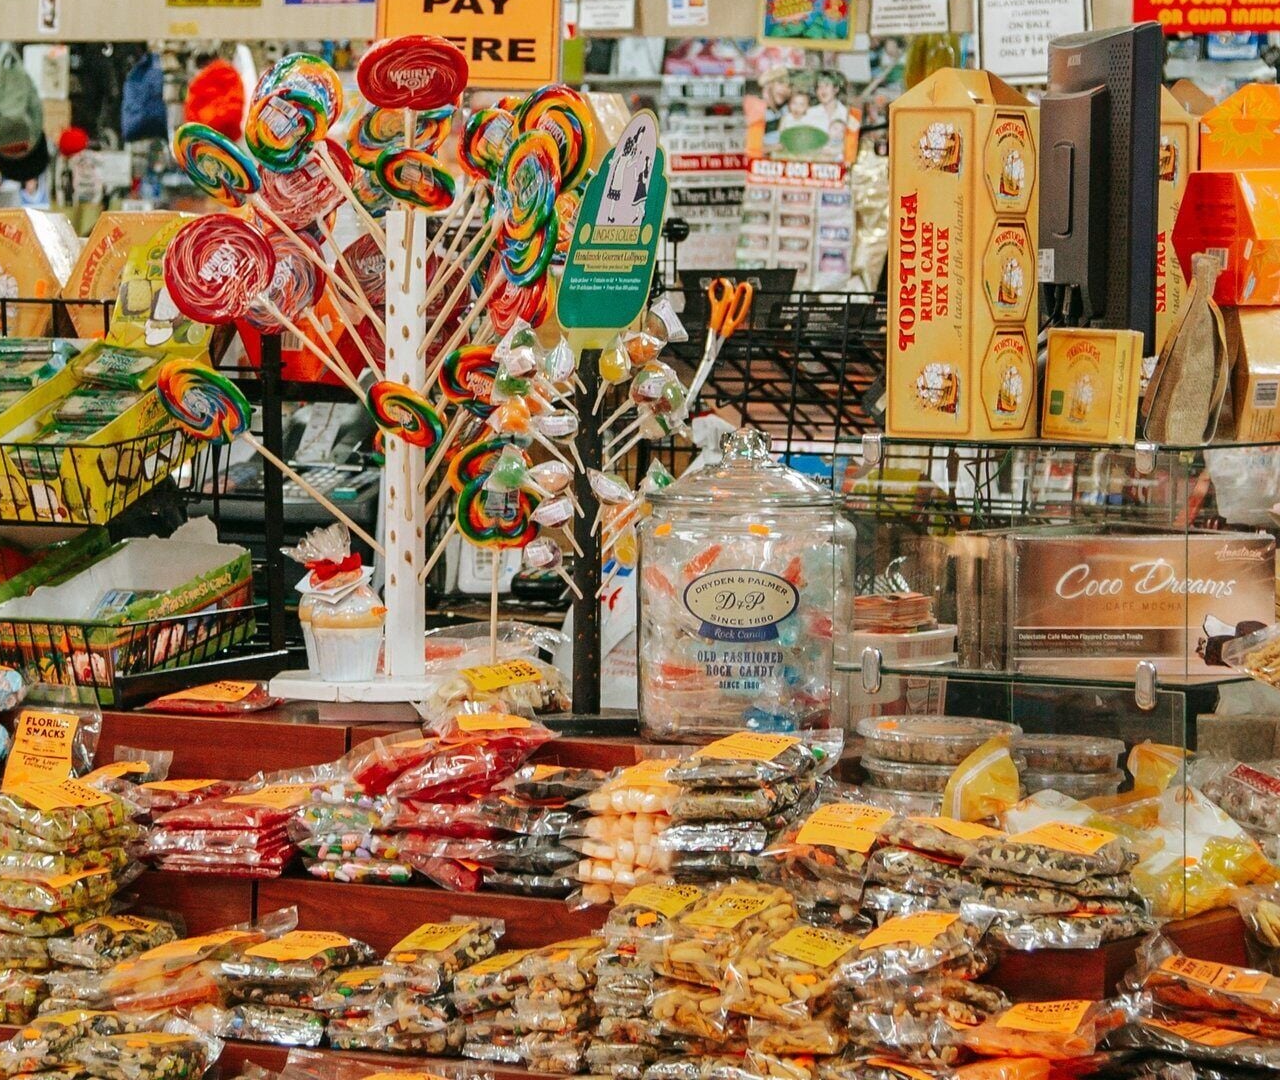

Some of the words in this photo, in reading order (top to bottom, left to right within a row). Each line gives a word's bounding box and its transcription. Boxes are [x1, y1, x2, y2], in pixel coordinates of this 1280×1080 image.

[1025, 20, 1051, 29] SALE
[1158, 7, 1183, 26] OR
[1187, 7, 1227, 26] GUM
[389, 67, 437, 83] WHIRLY
[920, 221, 934, 272] CAKE
[936, 226, 950, 273] PACK
[897, 188, 919, 354] TORTUGA
[919, 276, 934, 322] RUM
[936, 278, 950, 317] SIX
[993, 334, 1025, 356] TORTUGA
[695, 576, 735, 595] DRYDEN
[747, 577, 789, 597] PALMER
[1054, 563, 1124, 600] Coco
[1129, 557, 1237, 599] Dreams
[1142, 601, 1183, 611] MOCHA
[710, 614, 745, 626] SINCE
[749, 614, 774, 625] 1880
[1061, 633, 1079, 641] Mocha
[1103, 633, 1126, 641] Coconut
[697, 650, 717, 662] OLD
[723, 651, 784, 663] FASHIONED
[706, 664, 733, 677] ROCK
[739, 665, 775, 677] CANDY
[25, 726, 66, 739] SNACKS
